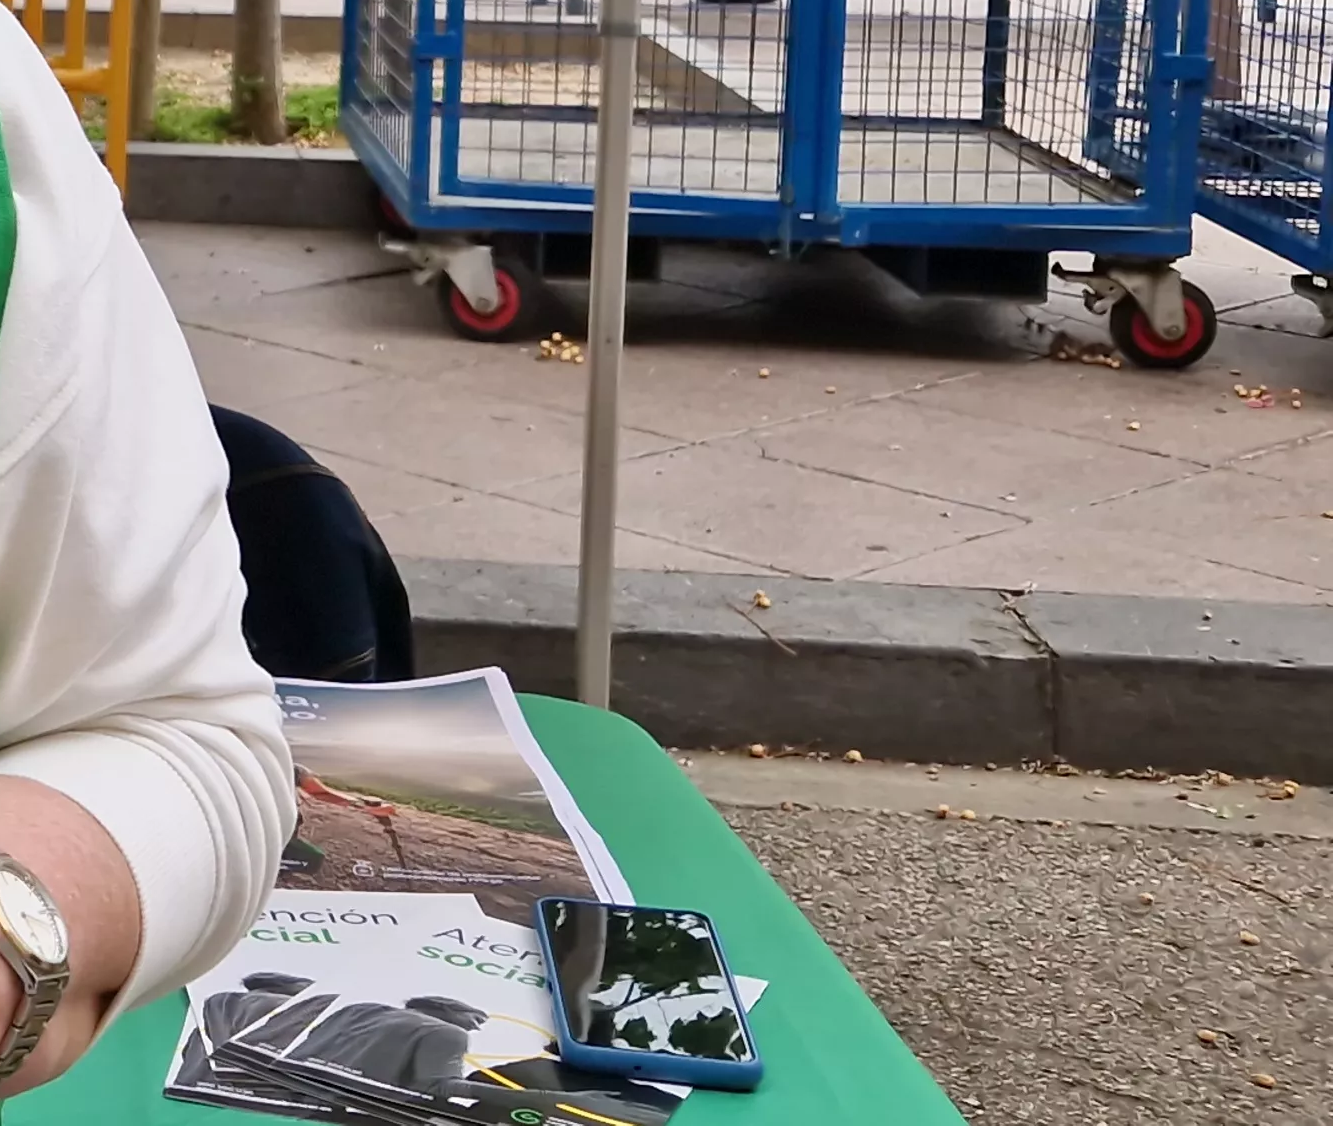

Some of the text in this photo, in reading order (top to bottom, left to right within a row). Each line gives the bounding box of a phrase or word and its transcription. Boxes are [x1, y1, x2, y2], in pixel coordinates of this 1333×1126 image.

[258, 907, 399, 926] nción
[243, 926, 341, 945] cial
[431, 927, 543, 966] Aten
[416, 945, 547, 990] socia
